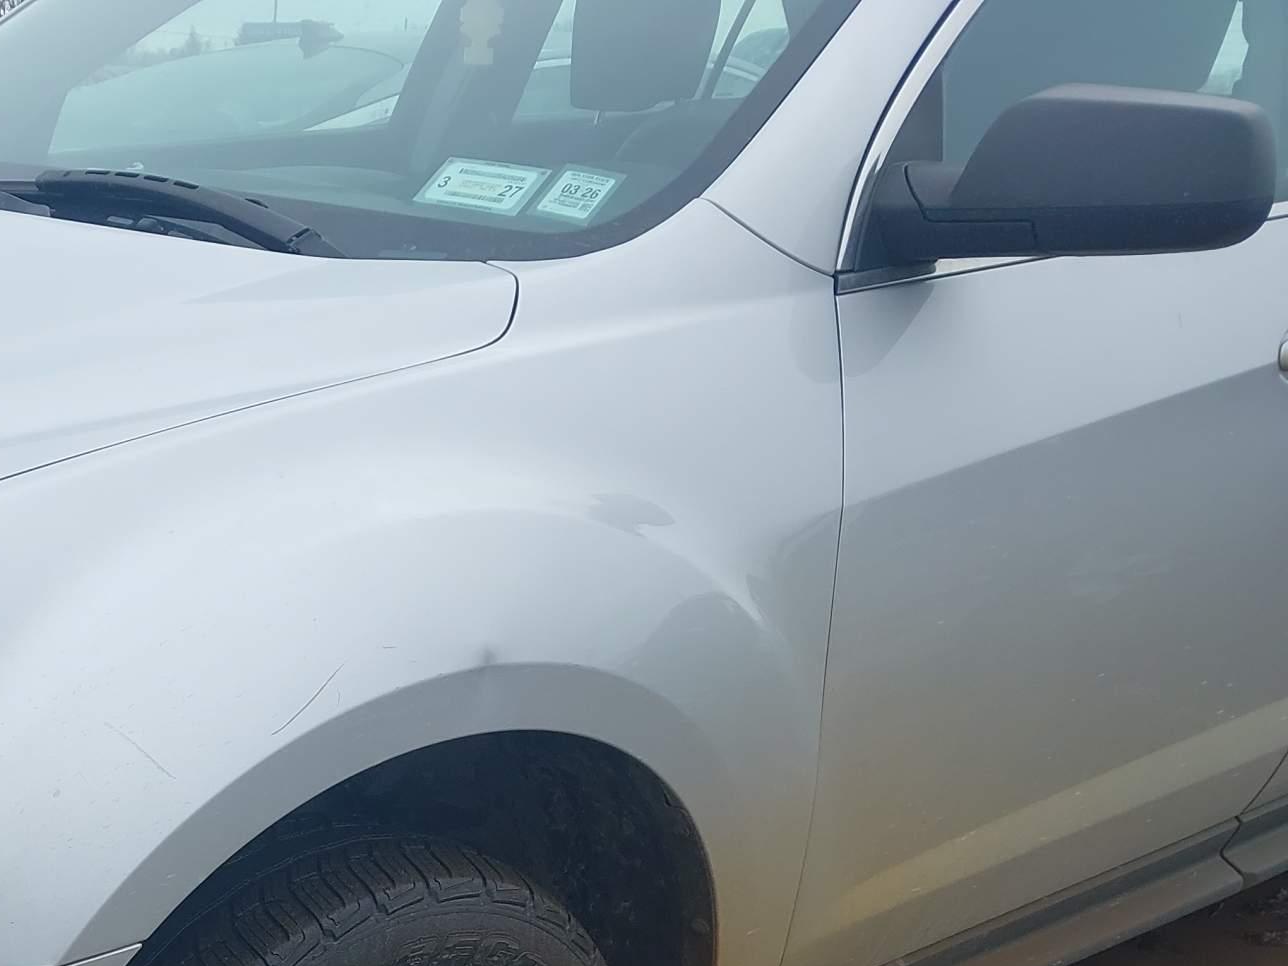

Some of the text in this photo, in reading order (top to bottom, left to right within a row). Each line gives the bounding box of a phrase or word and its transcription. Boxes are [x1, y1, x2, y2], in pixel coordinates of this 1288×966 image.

[437, 176, 451, 188] 3
[497, 184, 525, 198] 27
[561, 183, 580, 195] 03
[581, 187, 601, 199] 26
